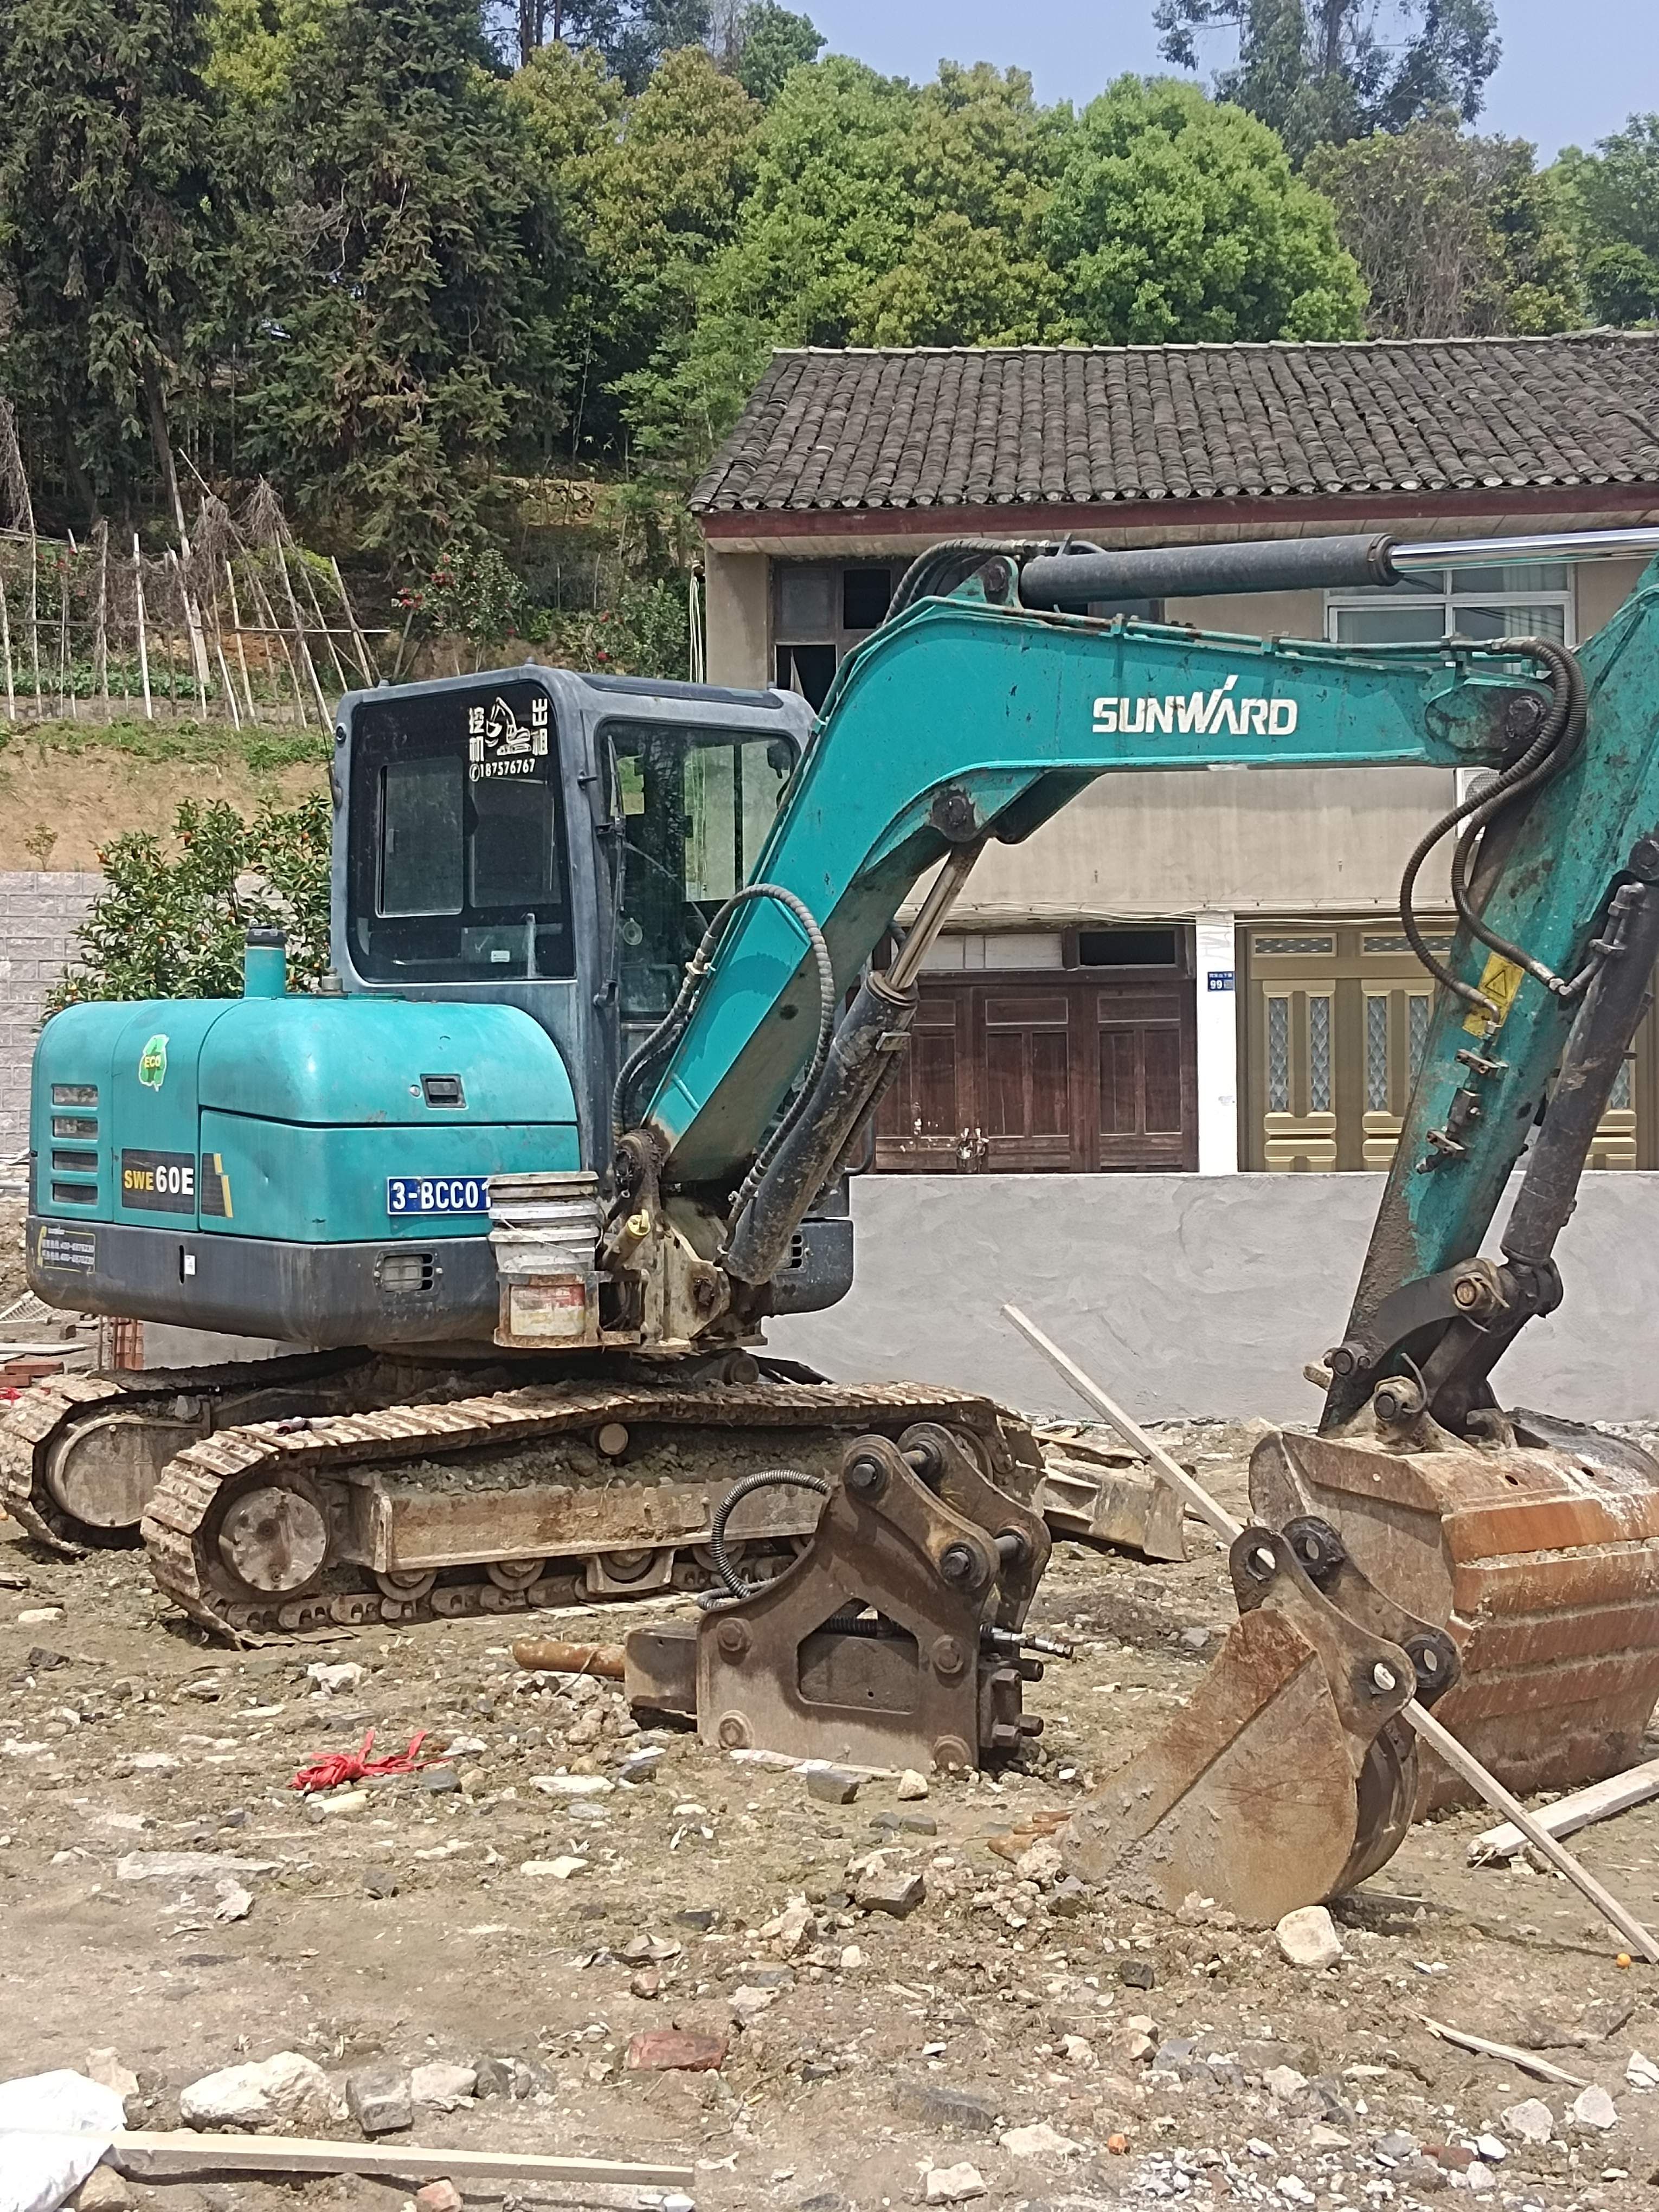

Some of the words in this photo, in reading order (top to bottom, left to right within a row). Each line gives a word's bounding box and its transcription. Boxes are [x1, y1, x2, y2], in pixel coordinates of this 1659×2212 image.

[532, 698, 548, 756] 出租
[1092, 674, 1298, 735] SUNWARD
[144, 1056, 161, 1069] ECO
